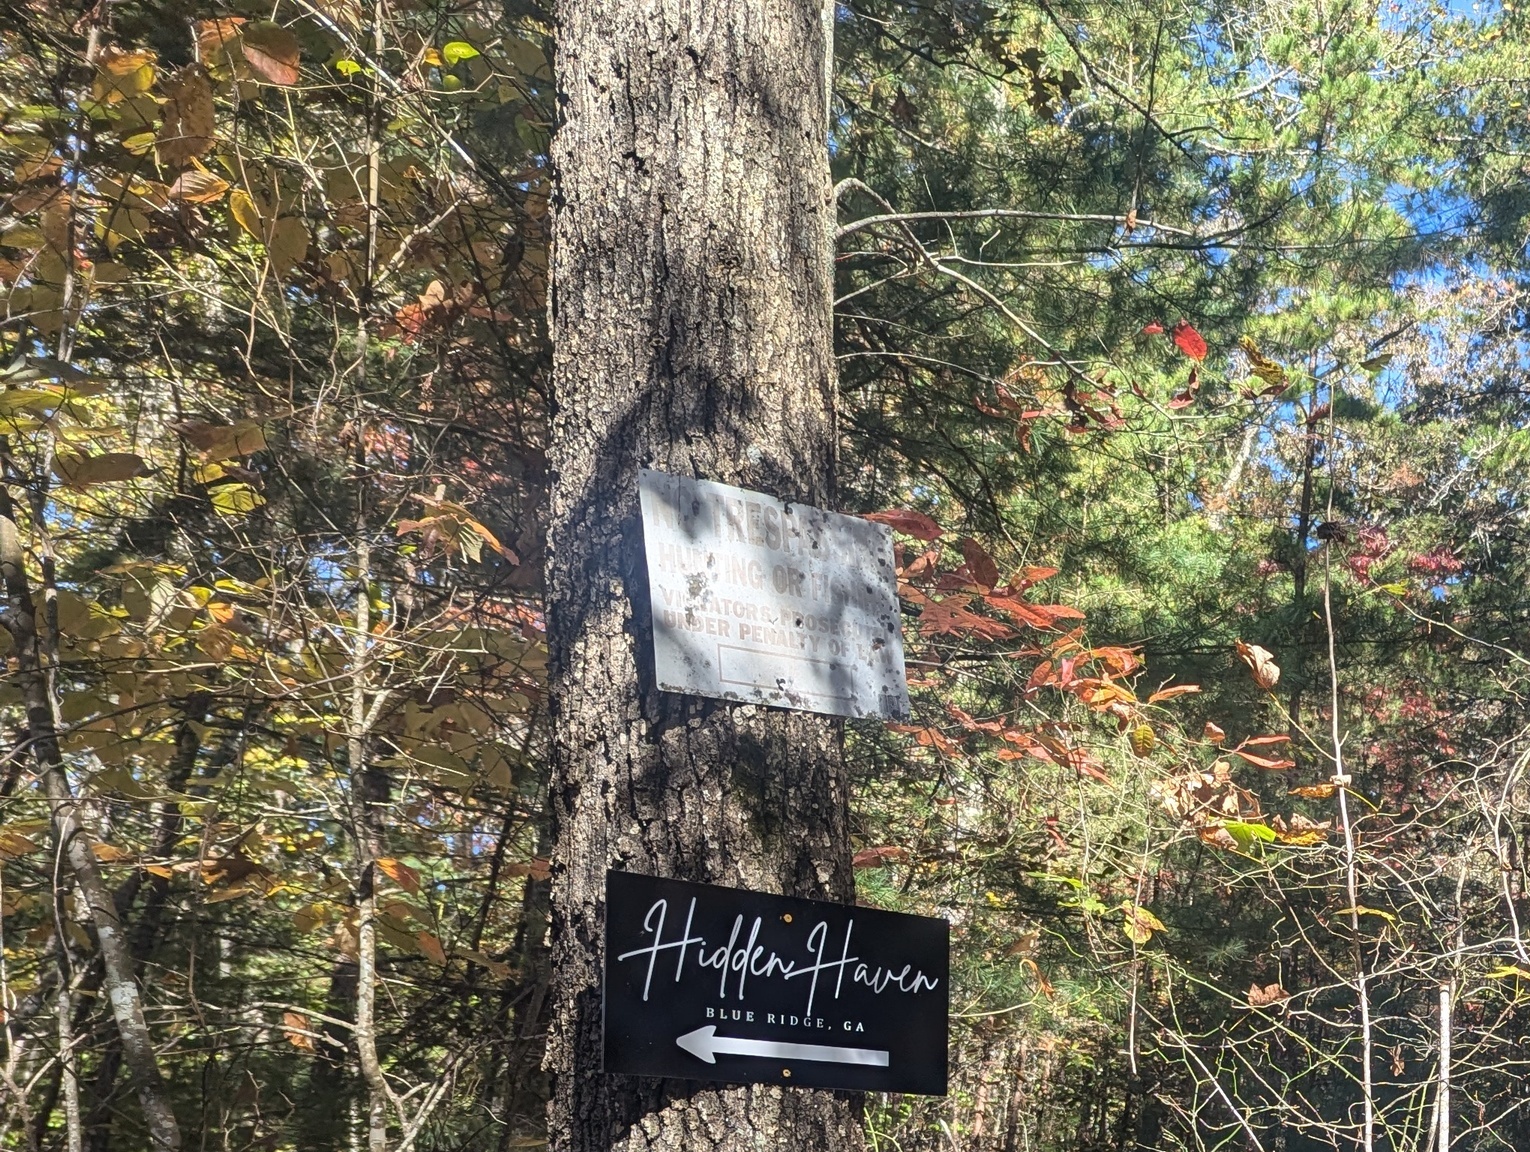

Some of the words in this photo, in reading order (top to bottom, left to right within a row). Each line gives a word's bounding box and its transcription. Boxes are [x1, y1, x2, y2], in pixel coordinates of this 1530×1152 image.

[771, 563, 803, 598] OR
[663, 610, 730, 637] UNDER
[738, 622, 821, 652] PENALTY
[827, 638, 851, 658] OF
[618, 897, 795, 1001] Hidden
[784, 919, 939, 1017] Haven
[706, 1007, 754, 1022] BLUE
[767, 1013, 832, 1030] RIDGE,
[843, 1021, 865, 1033] GA
